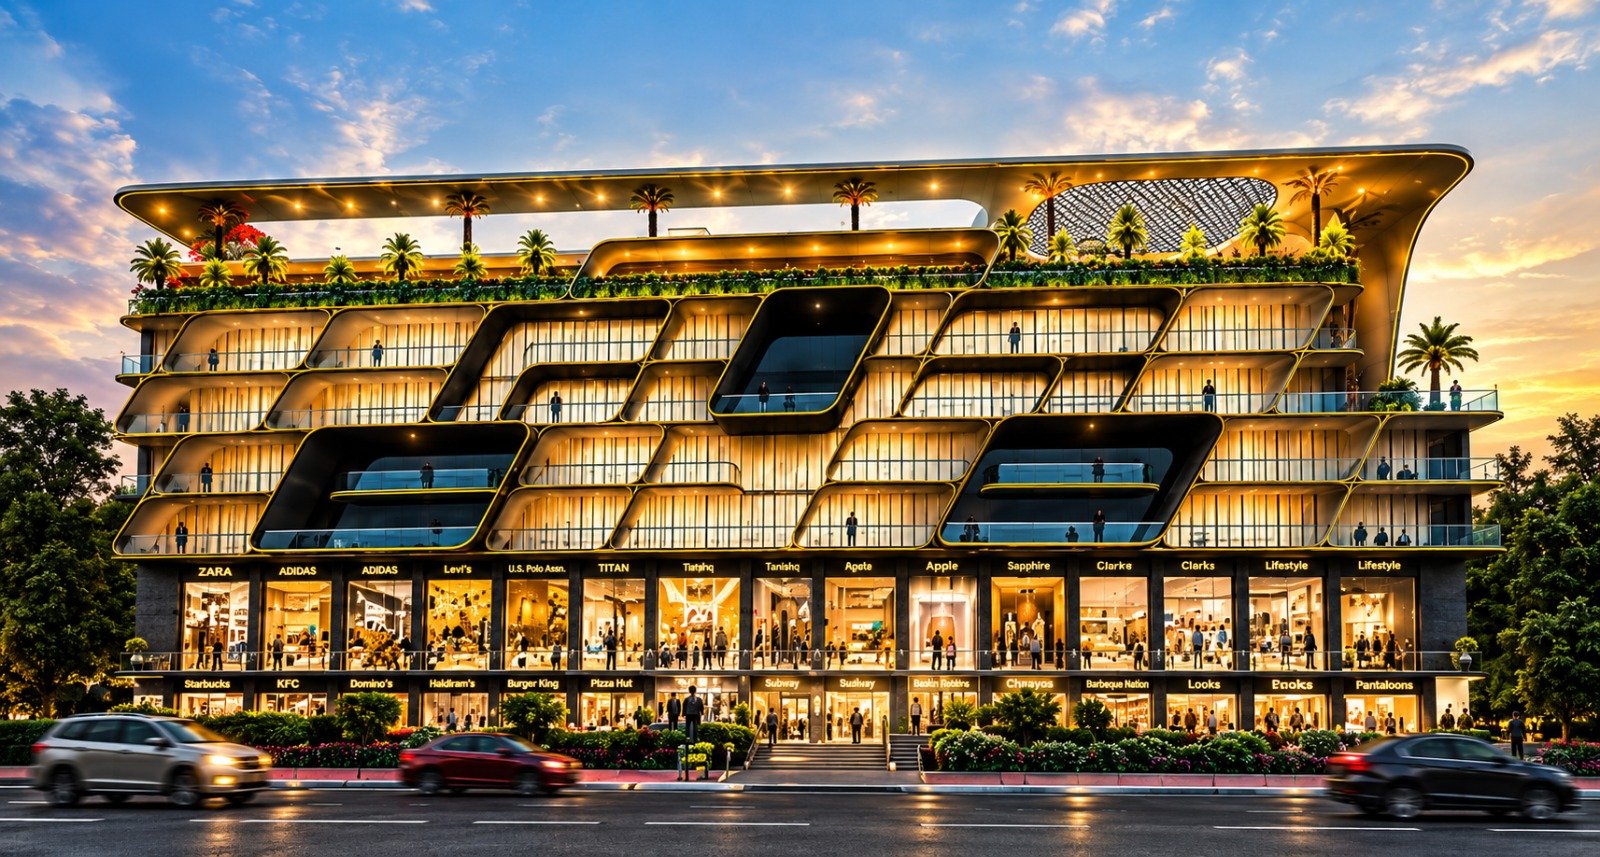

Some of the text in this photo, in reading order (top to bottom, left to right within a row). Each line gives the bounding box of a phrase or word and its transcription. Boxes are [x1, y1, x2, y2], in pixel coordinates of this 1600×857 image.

[197, 566, 234, 578] ZARA
[278, 565, 318, 577] ADIDAS
[361, 564, 400, 576] ADIDAS
[443, 564, 473, 575] Levi's
[507, 564, 567, 574] U.S. Polo Assn.
[597, 563, 631, 573] TITAN
[765, 561, 800, 573] Tanishq
[925, 560, 959, 573] Apple
[1007, 560, 1051, 573] Sapphire
[1265, 560, 1309, 573] Lifestyle
[1358, 560, 1402, 572] Lifestyle
[183, 678, 231, 690] Starbucks
[276, 678, 300, 689] KFC
[349, 678, 394, 690] Domino's
[429, 678, 476, 689] Haldiram's
[507, 678, 560, 690] Burger King
[590, 678, 633, 688] Pizza Hut
[764, 677, 800, 691] Subway
[1086, 678, 1123, 691] Barbeque
[1187, 679, 1221, 690] Looks
[1355, 679, 1414, 690] Pantaloons
